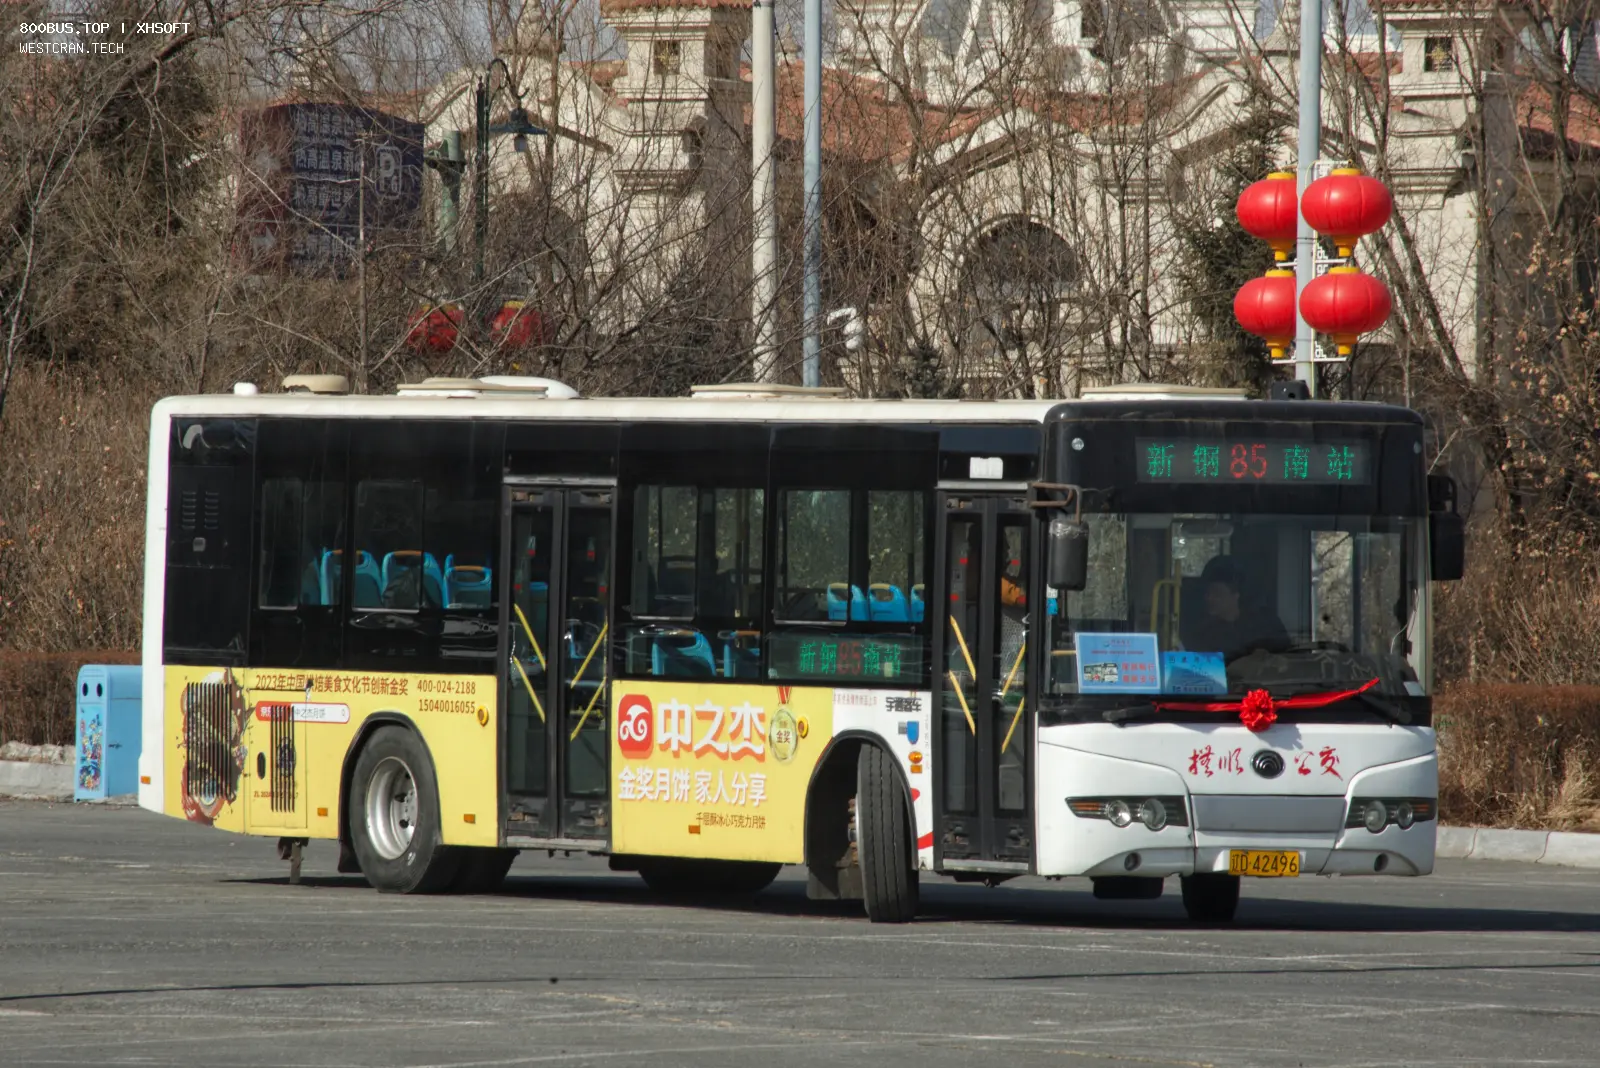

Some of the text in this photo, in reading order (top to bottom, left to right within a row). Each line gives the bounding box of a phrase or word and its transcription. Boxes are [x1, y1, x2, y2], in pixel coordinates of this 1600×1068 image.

[1230, 443, 1267, 478] 85
[1284, 444, 1354, 480] 南站
[417, 678, 476, 695] 400-024-2188
[419, 698, 475, 714] 15040016055
[656, 698, 766, 761] 中之杰
[776, 730, 791, 744] 金奖
[1294, 745, 1344, 781] 公交
[618, 765, 768, 808] 金奖月饼 家人分享
